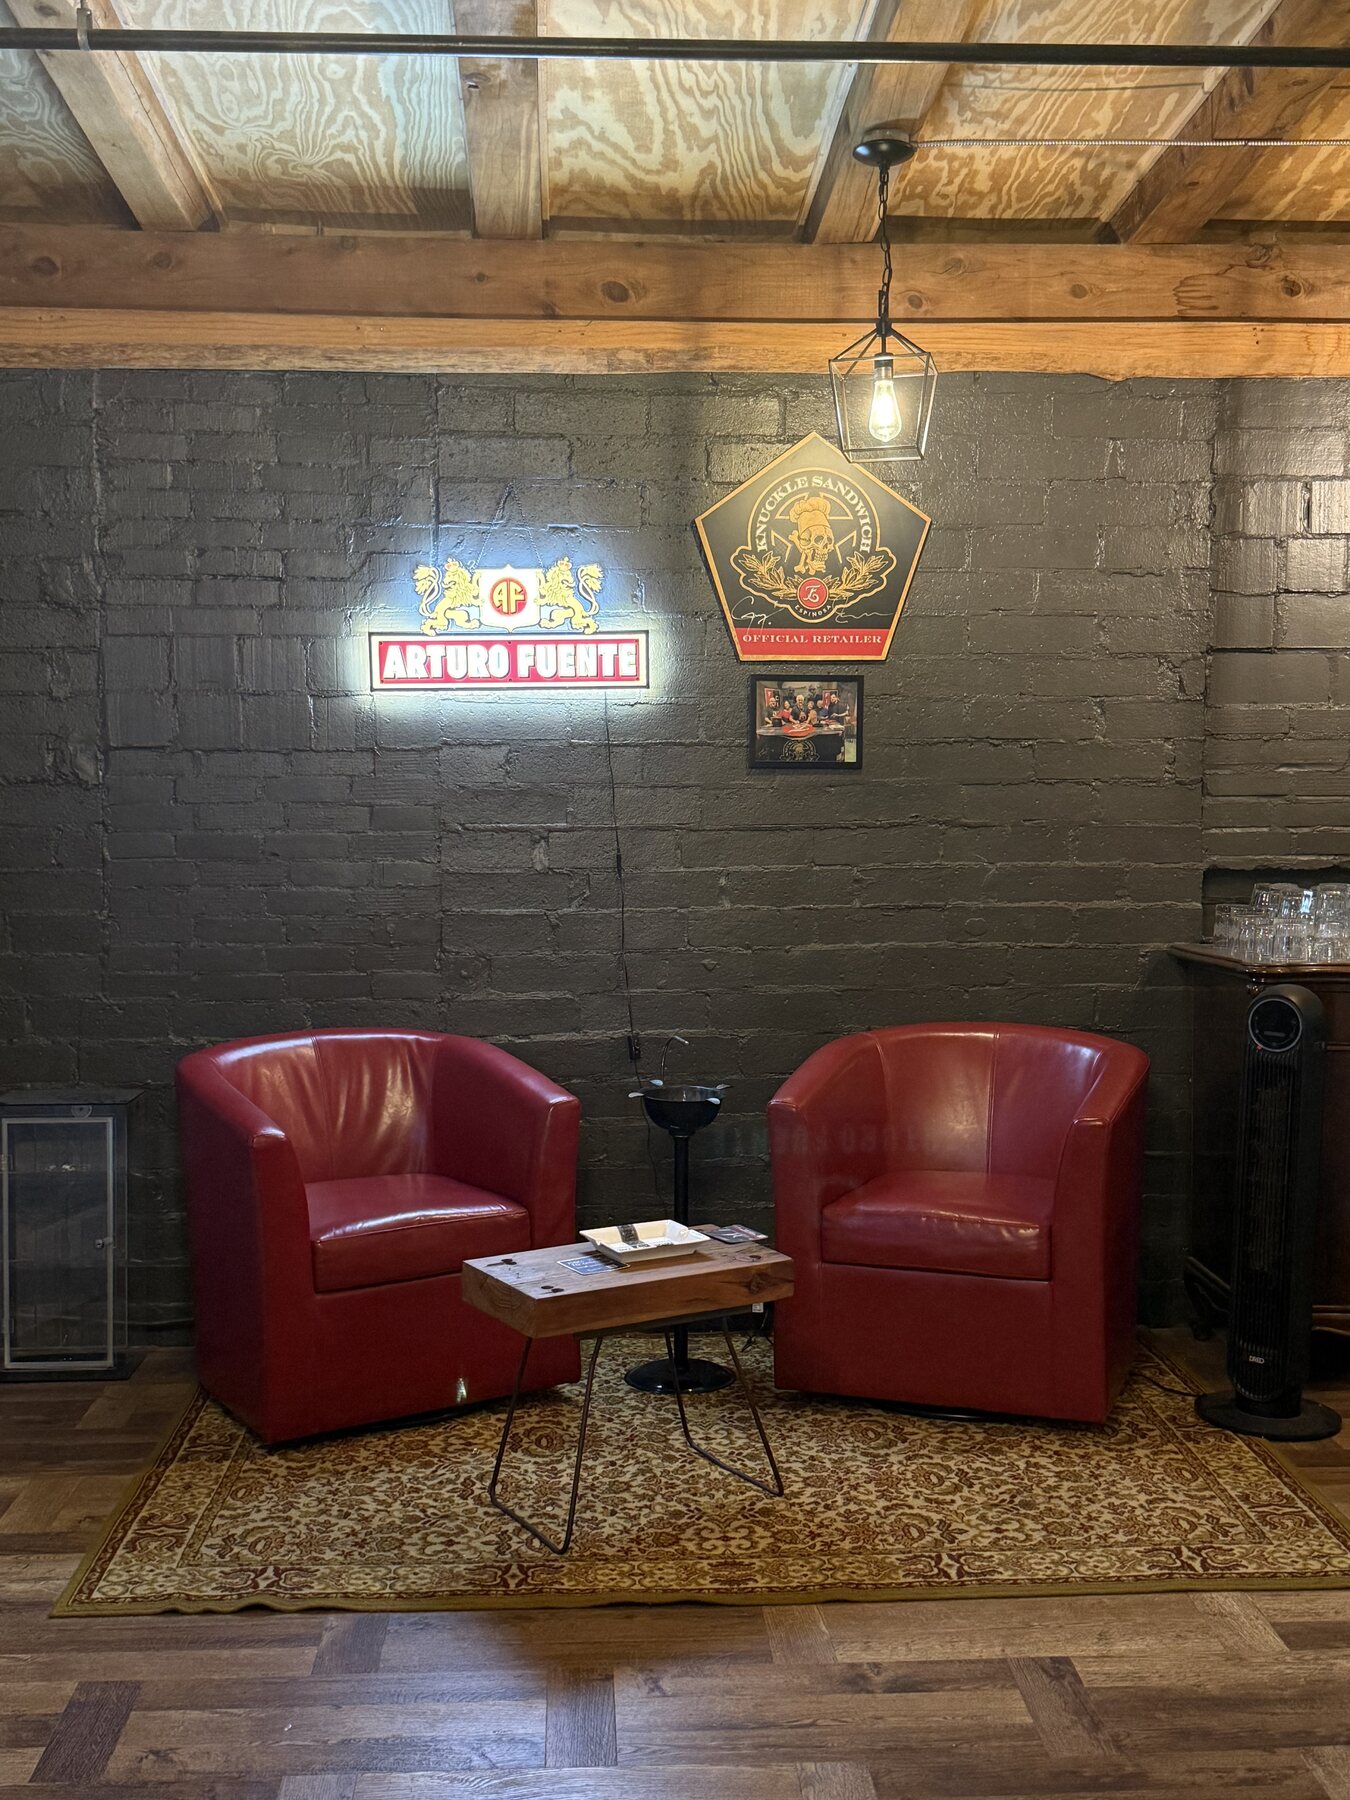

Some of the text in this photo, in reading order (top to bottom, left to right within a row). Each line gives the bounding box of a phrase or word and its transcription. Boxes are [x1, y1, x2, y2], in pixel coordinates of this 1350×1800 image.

[756, 475, 873, 553] KNUCKLE SANDWICH
[492, 582, 525, 614] AF
[794, 603, 832, 617] ESPINOSA
[742, 635, 882, 643] OFFICIAL RETAILER
[383, 643, 638, 679] ARTURO FUENTE
